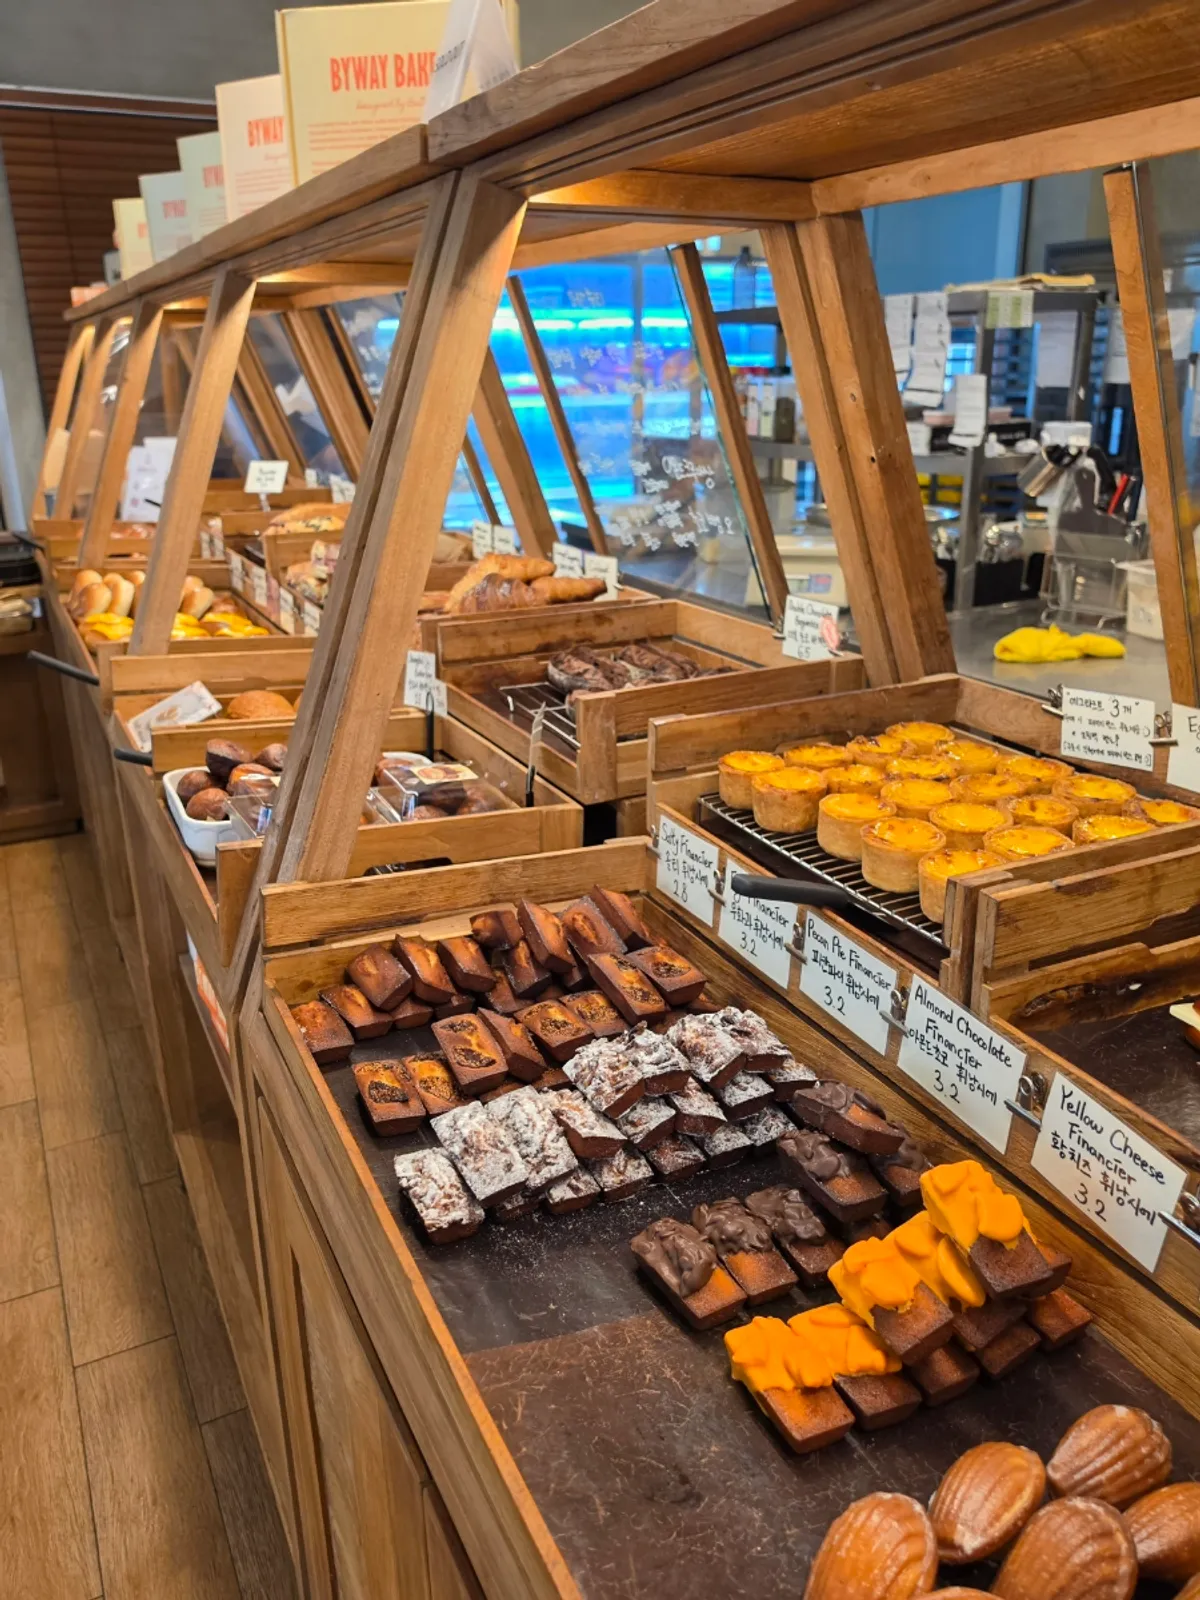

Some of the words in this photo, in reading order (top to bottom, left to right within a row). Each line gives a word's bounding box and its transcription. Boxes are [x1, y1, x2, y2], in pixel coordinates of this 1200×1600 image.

[329, 54, 389, 92] BYWAY
[665, 850, 680, 876] 솔티
[681, 860, 709, 889] 휘낭시에
[680, 834, 713, 869] Financier
[739, 930, 758, 957] 3.2
[753, 915, 785, 951] 휘낭시에
[807, 917, 829, 951] Pecan
[832, 935, 847, 960] Pie
[849, 949, 892, 991] Financier
[811, 949, 844, 984] 피칸파이
[845, 972, 880, 1011] 휘낭시에
[823, 985, 846, 1017] 3.2
[914, 984, 954, 1024] Almond
[956, 1016, 1013, 1068] Chocolate
[925, 1017, 983, 1069] Financier
[933, 1069, 961, 1104] 3.2
[955, 1061, 998, 1106] 휘낭시에
[1060, 1084, 1104, 1135] Yellow
[1109, 1128, 1166, 1186] Cheese
[1067, 1121, 1137, 1186] Financier
[1051, 1130, 1092, 1179] 황치즈
[1099, 1170, 1156, 1226] 휘낭시에
[1074, 1182, 1108, 1223] 3.2
